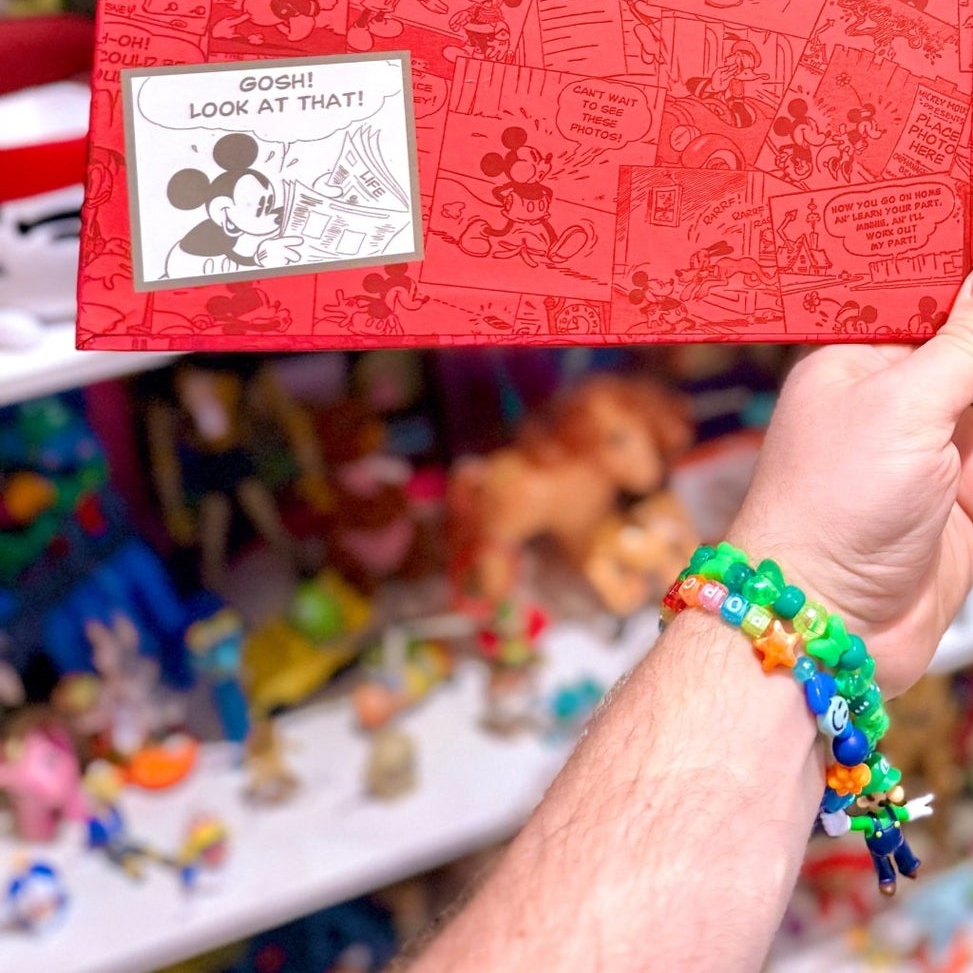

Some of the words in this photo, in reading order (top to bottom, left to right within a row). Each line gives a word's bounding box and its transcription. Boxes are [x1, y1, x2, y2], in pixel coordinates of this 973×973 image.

[239, 72, 314, 92] GOSH!
[190, 100, 249, 119] LOOK
[257, 97, 289, 115] AT
[298, 90, 364, 111] THAT!
[572, 85, 606, 100] CAN'T
[608, 93, 638, 108] WAIT
[917, 89, 945, 106] MICKEY
[582, 99, 598, 110] TO
[601, 105, 624, 117] SEE
[582, 112, 618, 128] THESE
[915, 112, 961, 142] PLACE
[569, 123, 623, 143] PHOTOS!
[907, 123, 957, 156] PHOTO
[908, 139, 946, 165] HERE
[358, 169, 387, 199] LIFE
[831, 202, 854, 214] NOW
[856, 199, 878, 210] YOU
[881, 195, 896, 205] GO
[899, 192, 913, 202] ON
[914, 187, 942, 200] HOME
[852, 208, 882, 221] LEARN
[884, 204, 911, 215] YOUR
[865, 230, 895, 241] WORK
[896, 224, 918, 236] OUT
[870, 241, 885, 252] MY
[887, 235, 917, 248] PART!
